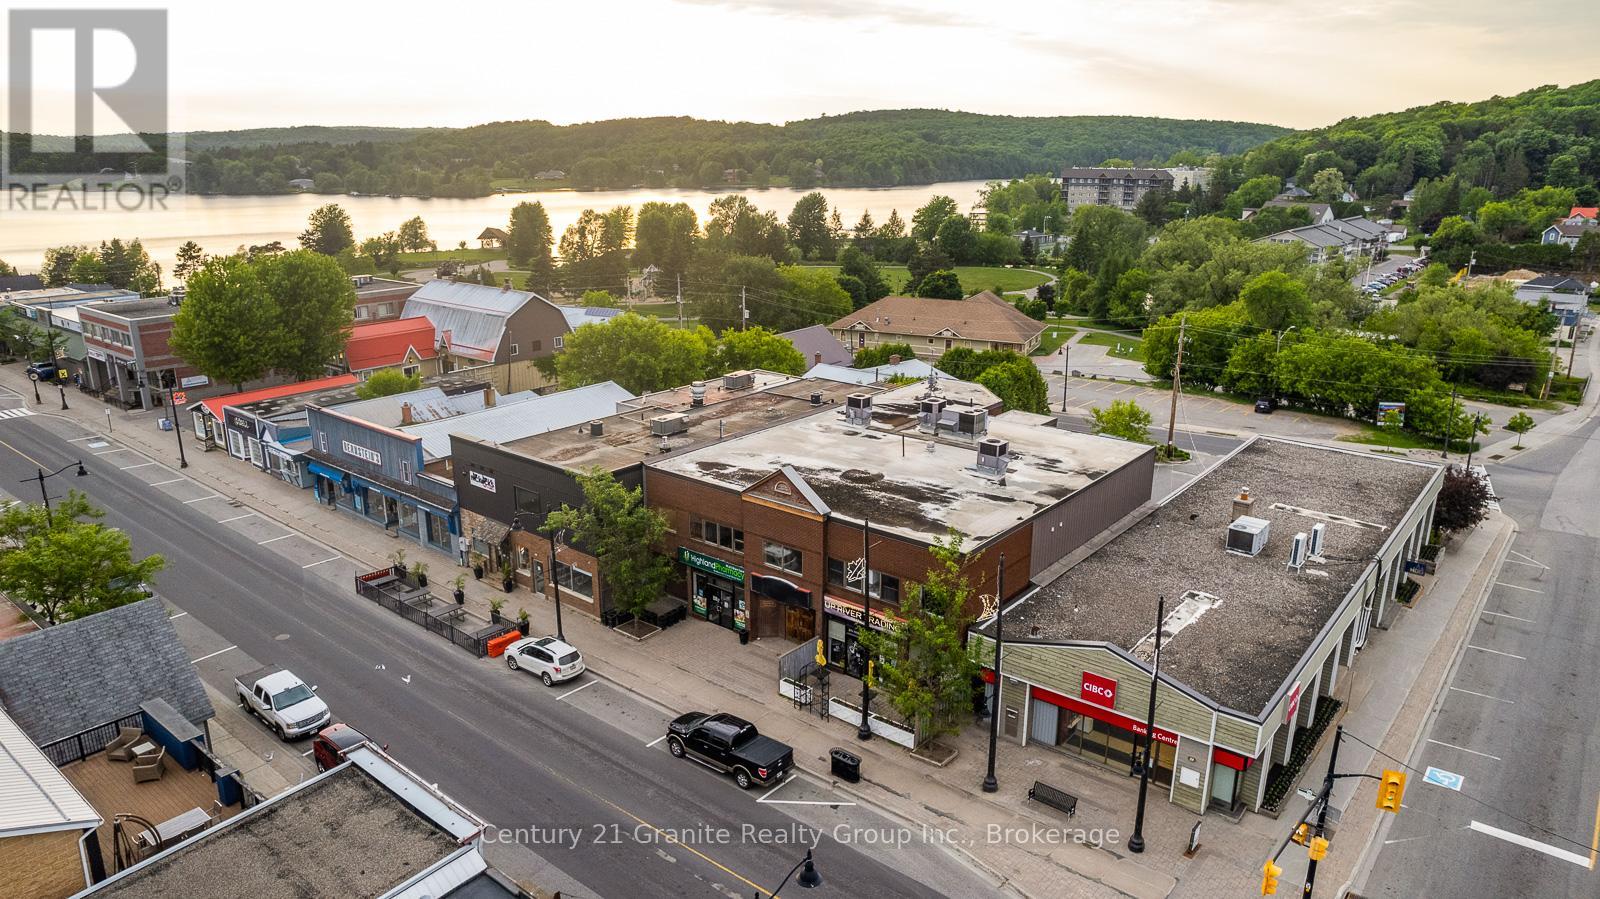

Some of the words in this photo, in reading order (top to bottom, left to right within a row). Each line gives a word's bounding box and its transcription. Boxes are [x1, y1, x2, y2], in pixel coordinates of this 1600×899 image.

[824, 600, 837, 611] UP
[837, 603, 862, 619] RIVER
[863, 614, 900, 632] RADING
[1083, 683, 1104, 696] CIBC
[1132, 724, 1157, 739] Bankg
[1157, 733, 1178, 745] Centre
